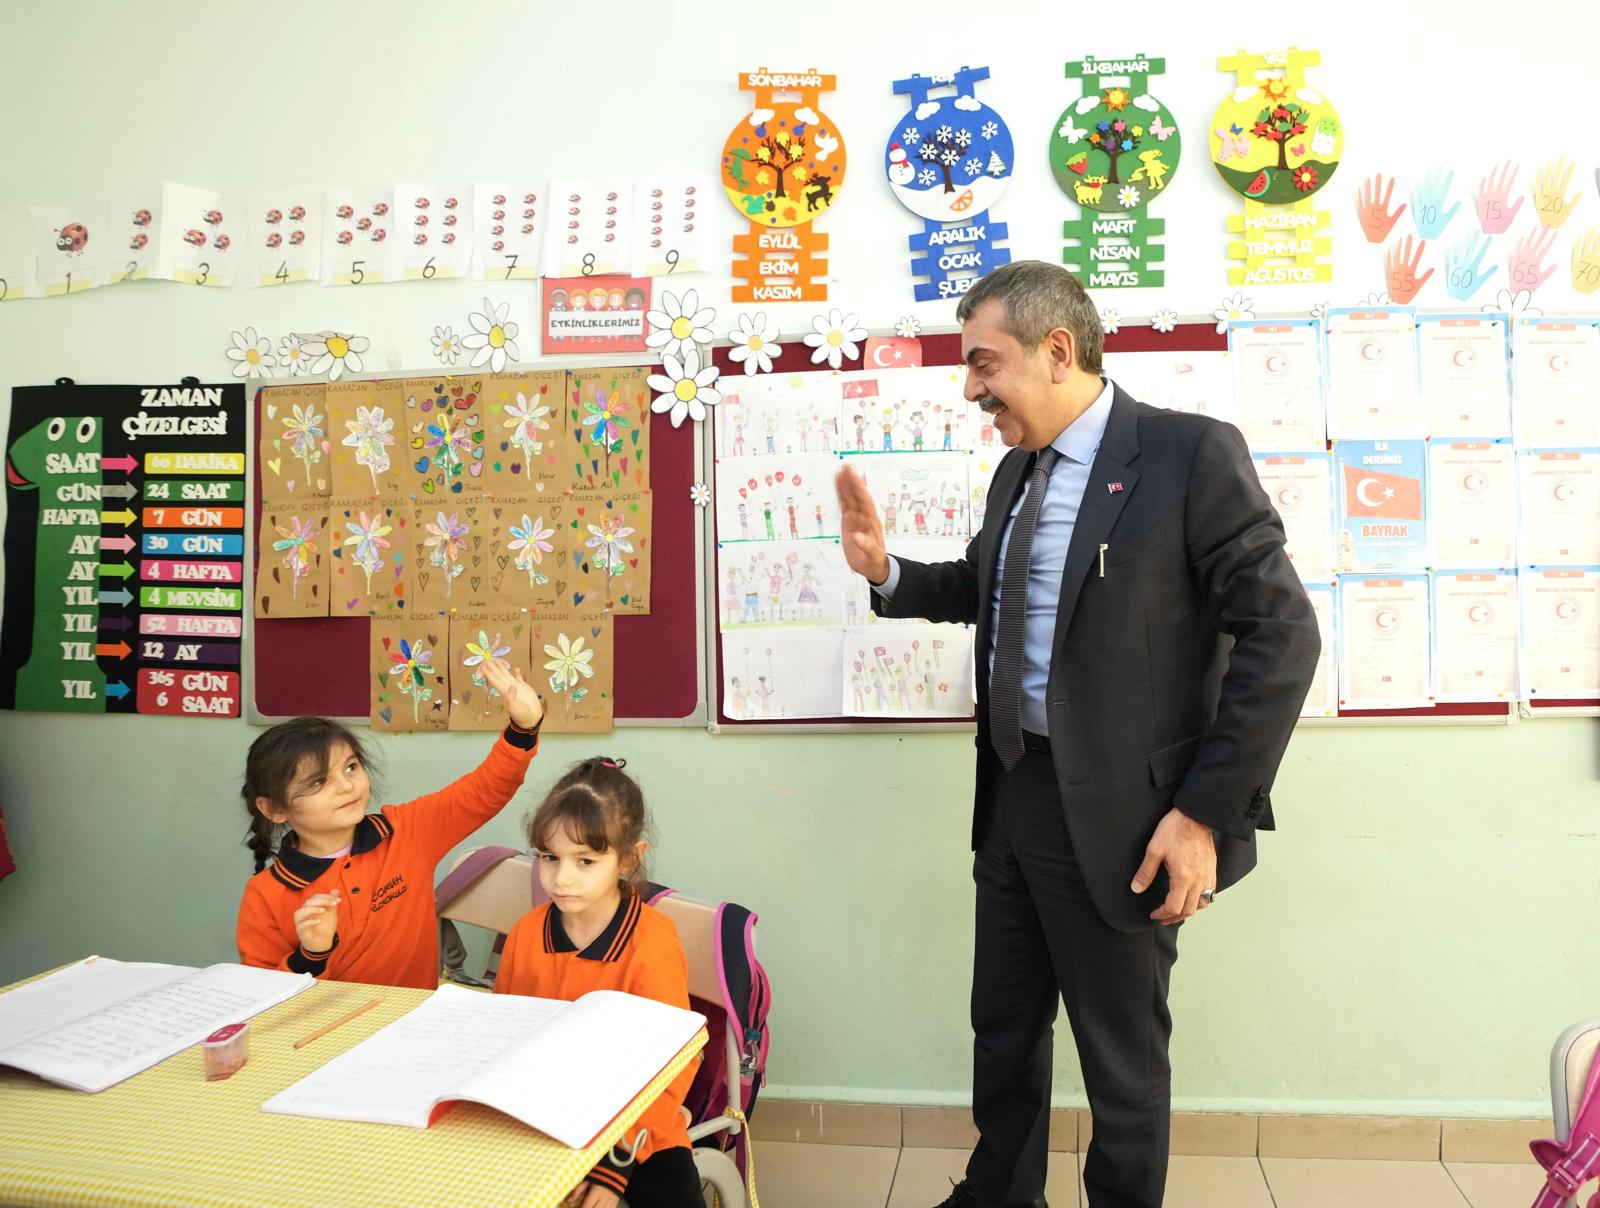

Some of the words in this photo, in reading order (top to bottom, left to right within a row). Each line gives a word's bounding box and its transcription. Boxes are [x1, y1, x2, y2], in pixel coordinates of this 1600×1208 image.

[1082, 60, 1149, 75] İLKBAHAR
[748, 74, 822, 88] SONBAHAR
[1420, 204, 1437, 224] 10
[1484, 200, 1502, 220] 15
[1540, 195, 1563, 215] 20
[1092, 220, 1137, 234] MART
[1371, 208, 1383, 229] 5
[759, 233, 802, 249] EYLÜL
[929, 226, 986, 247] ARALIK
[665, 250, 679, 274] 9
[938, 253, 982, 270] OCAK
[1090, 244, 1140, 261] NİSAN
[120, 260, 138, 282] 2
[195, 262, 211, 286] 3
[275, 260, 289, 284] 4
[350, 261, 366, 285] 5
[422, 256, 436, 279] 6
[504, 254, 519, 280] 7
[581, 253, 596, 276] 8
[759, 258, 799, 274] EKİM
[1513, 261, 1538, 285] 65
[64, 271, 72, 294] 1
[1090, 272, 1139, 288] MAYIS
[1450, 266, 1473, 289] 60
[753, 286, 802, 300] KASIM
[550, 318, 641, 328] ETKİNLİKLERİMİZ
[140, 387, 224, 408] ZAMAN
[122, 411, 228, 440] ÇİZELGESİ
[45, 452, 102, 474] SAAT
[175, 453, 240, 470] DAKİKA
[56, 484, 101, 502] GÜN
[147, 483, 170, 498] 24
[181, 483, 231, 499] SAAT
[42, 509, 100, 527] HAFTA
[152, 509, 165, 525] 7
[181, 508, 223, 527] GÜN
[1362, 524, 1408, 538] BAYRAK
[69, 534, 100, 555] AY
[147, 535, 169, 550] 30
[182, 534, 224, 553] GÜN
[67, 561, 100, 581] AY
[147, 561, 160, 579] 4
[172, 563, 234, 580] HAFTA
[62, 586, 98, 606] YIL
[148, 587, 160, 606] 4
[166, 587, 236, 608] MEVSİM
[62, 613, 98, 633] YIL
[147, 616, 167, 632] 52
[176, 616, 238, 634] HAFTA
[60, 641, 96, 661] YIL
[143, 641, 165, 659] 12
[174, 644, 203, 661] AY
[61, 679, 96, 699] YIL
[148, 671, 175, 686] 365
[182, 671, 229, 692] GÜN
[156, 691, 168, 707] 6
[182, 697, 234, 714] SAAT
